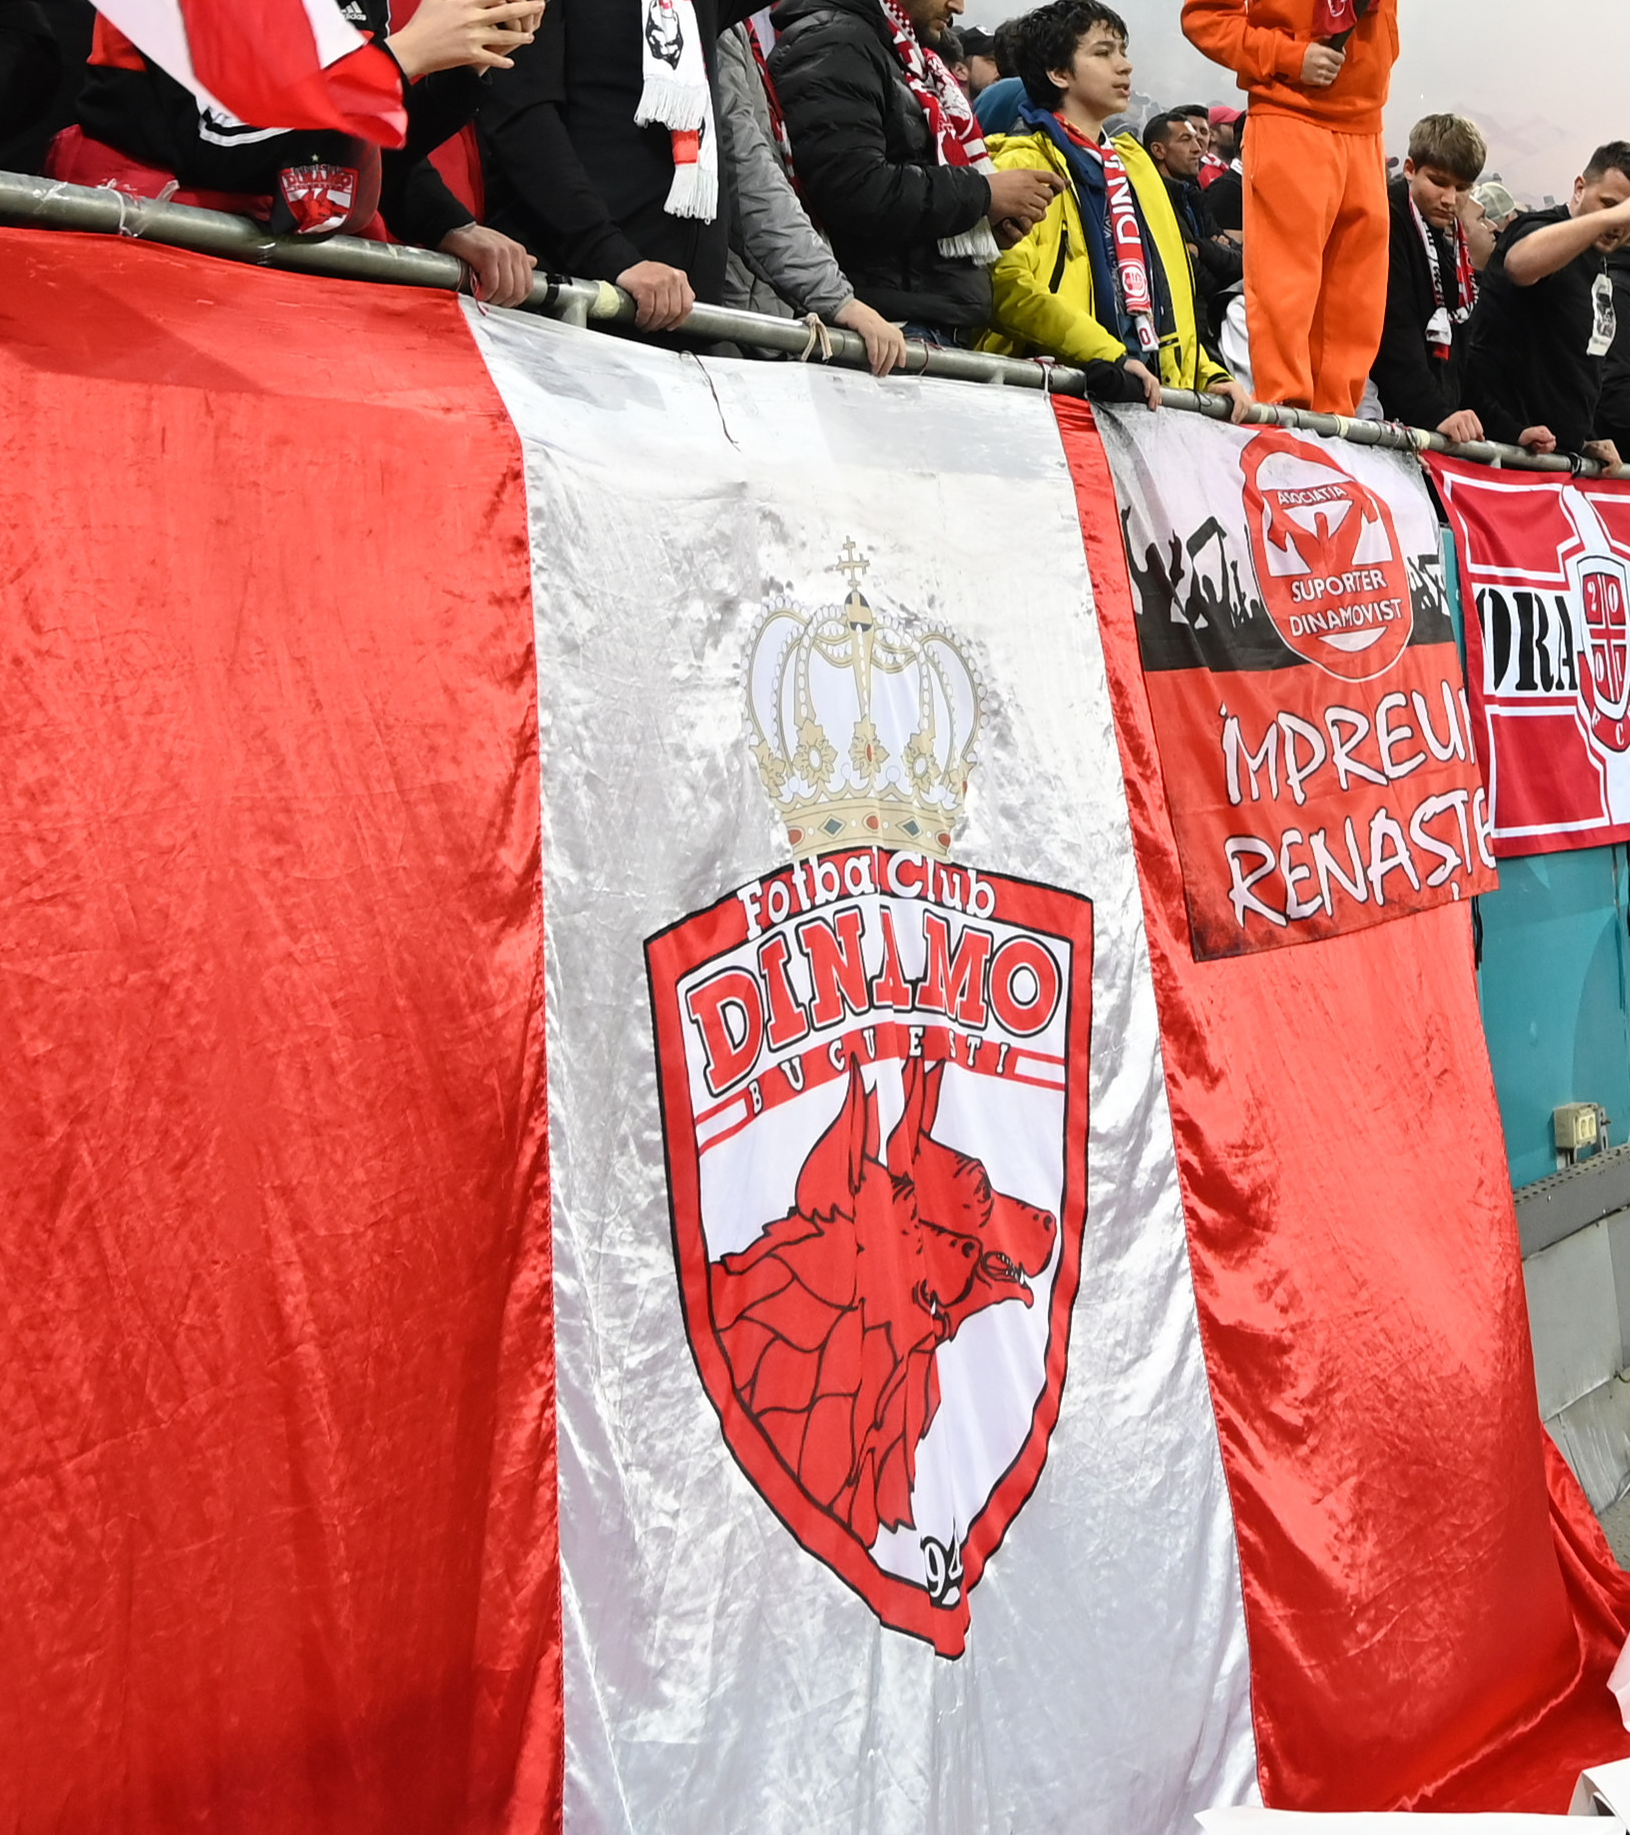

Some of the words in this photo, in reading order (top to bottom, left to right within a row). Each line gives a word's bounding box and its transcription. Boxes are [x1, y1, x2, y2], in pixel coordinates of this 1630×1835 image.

[1289, 598, 1403, 638] DINAMOVIST
[1290, 569, 1387, 604] SUPORTER
[887, 848, 997, 920] Club
[685, 902, 1063, 1099] DINAMO
[747, 1022, 1011, 1117] BUCUESTI
